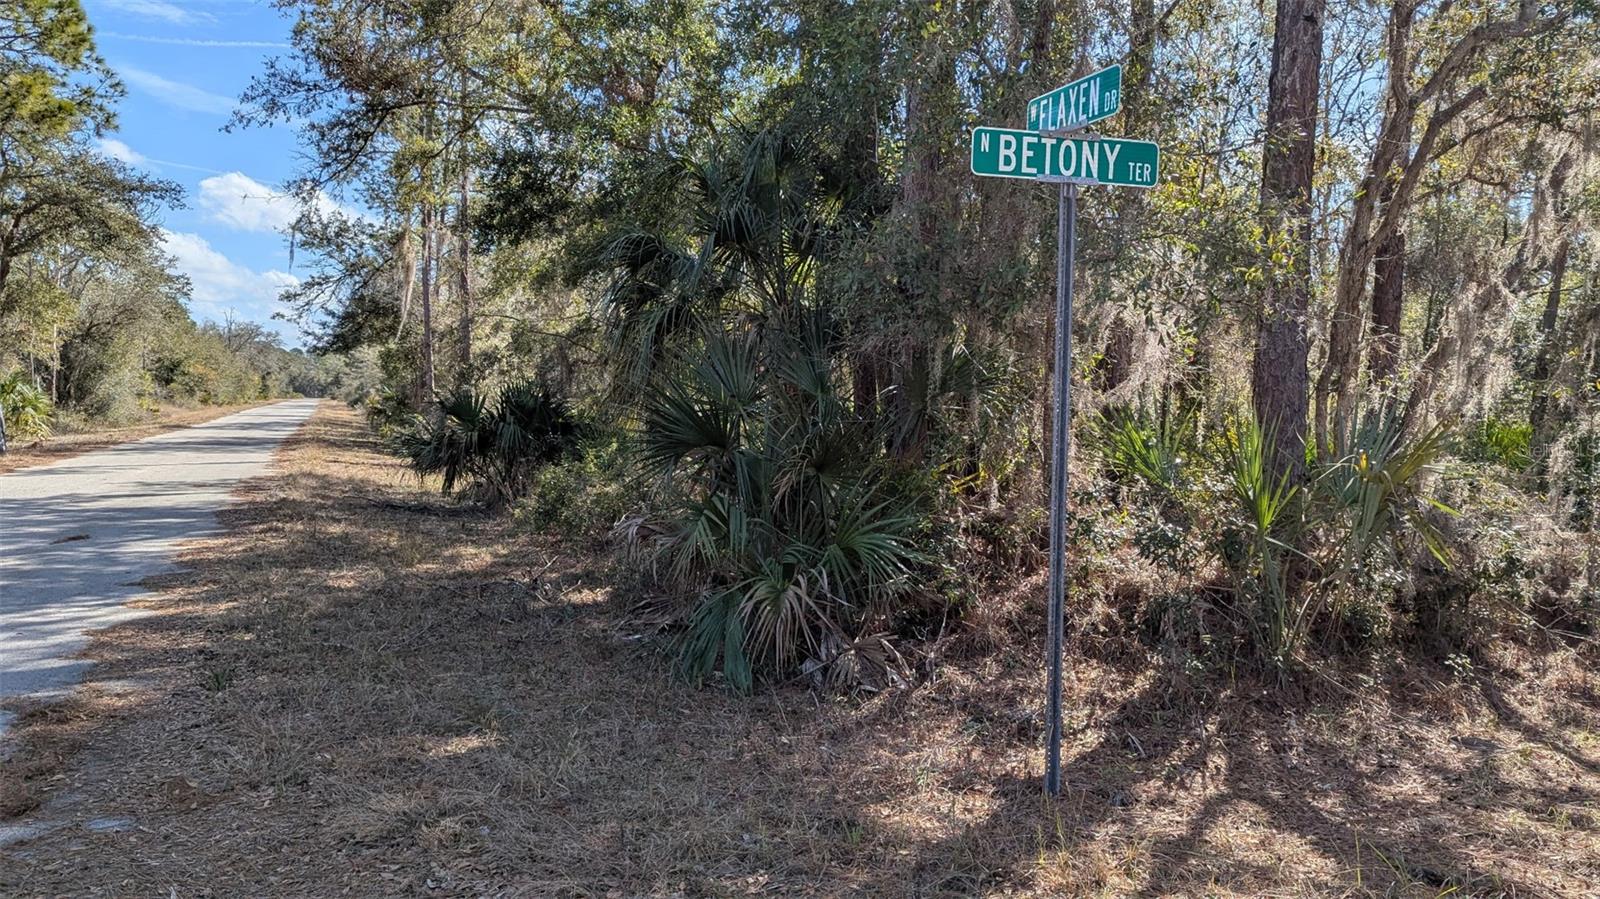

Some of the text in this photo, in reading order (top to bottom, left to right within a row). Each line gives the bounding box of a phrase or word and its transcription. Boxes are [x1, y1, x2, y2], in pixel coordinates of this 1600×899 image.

[1030, 77, 1116, 131] W FLAXEN DR
[981, 132, 1152, 182] N BETONY TER
